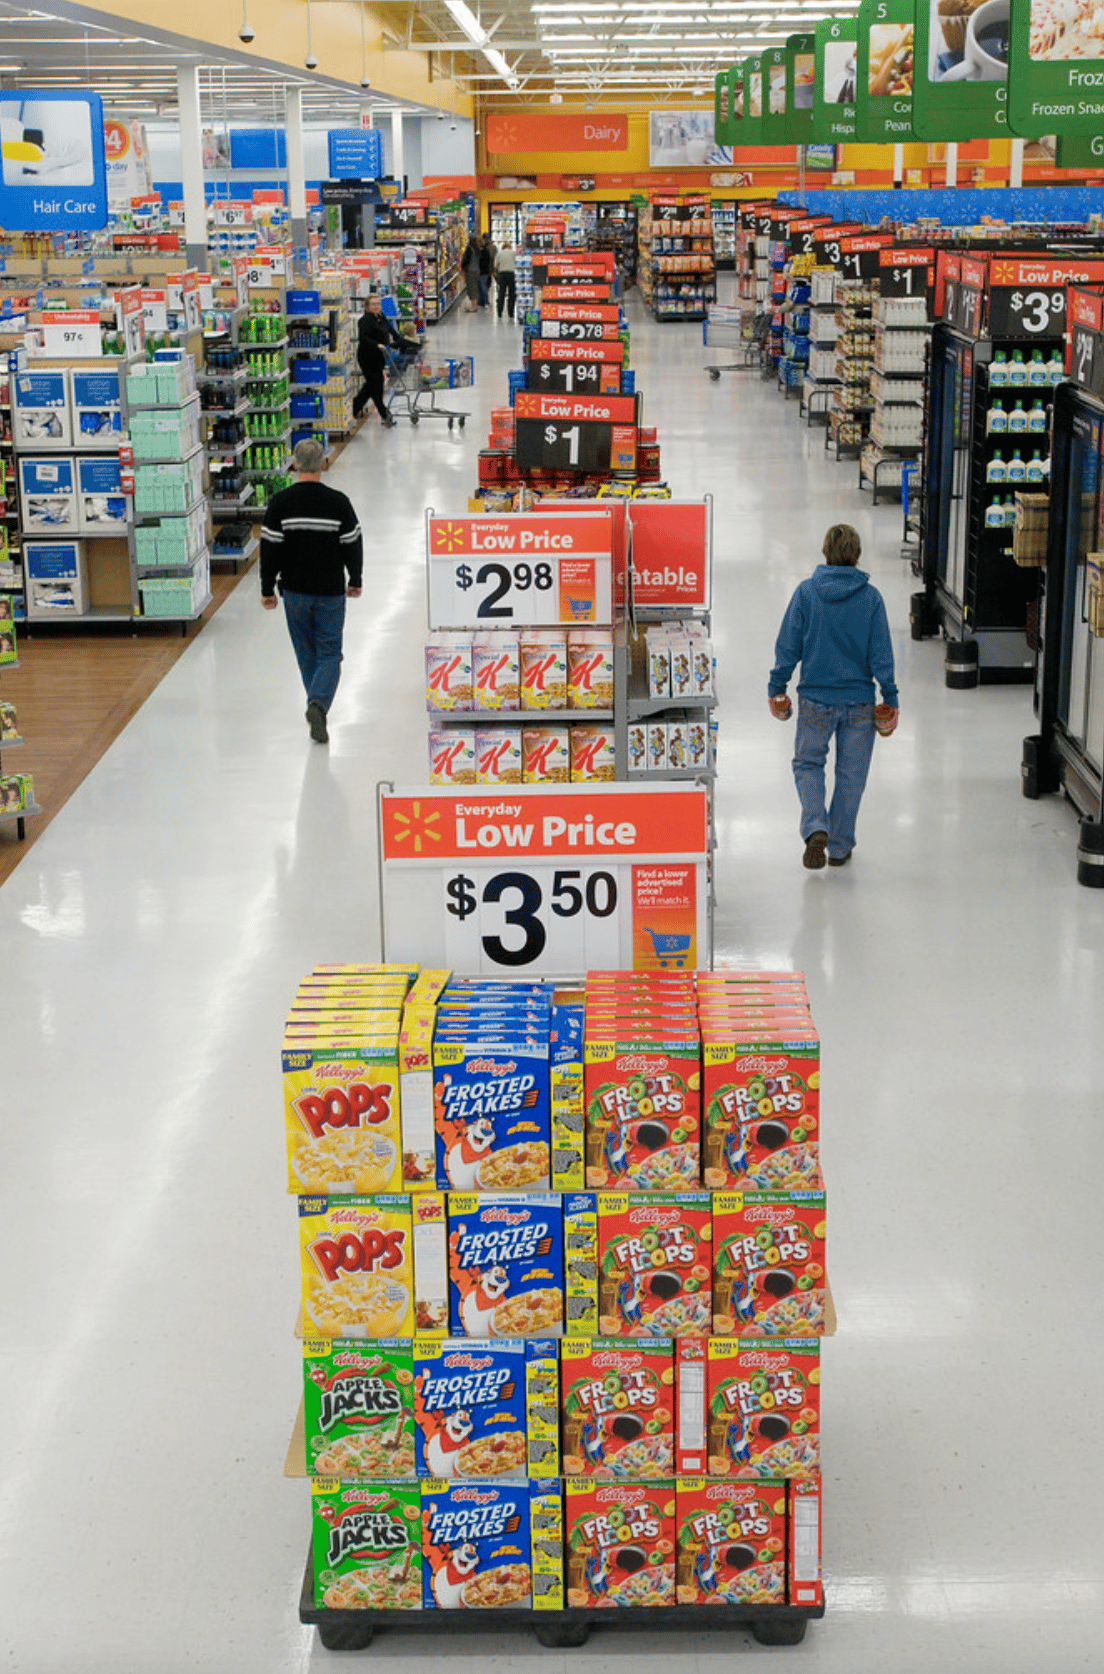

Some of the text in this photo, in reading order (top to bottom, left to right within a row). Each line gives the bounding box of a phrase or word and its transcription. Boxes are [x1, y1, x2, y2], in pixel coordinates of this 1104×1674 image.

[876, 4, 887, 18] 5
[800, 39, 807, 49] 7
[831, 24, 840, 37] 6
[773, 52, 781, 62] 8
[1032, 102, 1074, 115] Frozen
[584, 125, 621, 142] Dairy
[34, 200, 96, 213] Hair Care
[1018, 270, 1089, 283] Low Price
[551, 348, 605, 358] Low Price
[541, 403, 610, 418] Low Price
[470, 523, 510, 533] Everyday
[471, 531, 574, 550] Low Price
[456, 804, 522, 818] Everyday
[456, 814, 637, 848] Low Price
[637, 878, 683, 887] advertised
[444, 1075, 535, 1103] FROSTED
[298, 1082, 392, 1139] POPS
[446, 1092, 524, 1119] FLAKES
[618, 1092, 683, 1122] LOOPS
[738, 1092, 803, 1122] LOOPS
[459, 1224, 547, 1251] FROSTED
[313, 1229, 406, 1282] POPS
[461, 1239, 535, 1266] FLAKES
[631, 1243, 694, 1272] LOOPS
[745, 1242, 808, 1271] LOOPS
[333, 1378, 382, 1392] APPLE
[422, 1368, 511, 1396] FROSTED
[320, 1390, 399, 1427] JACKS
[425, 1383, 499, 1411] FLAKES
[594, 1387, 657, 1415] LOOPS
[741, 1387, 803, 1415] LOOPS
[342, 1515, 389, 1528] APPLE
[429, 1503, 515, 1529] FROSTED
[328, 1526, 406, 1563] JACKS
[432, 1519, 504, 1544] FLAKES
[597, 1521, 659, 1548] LOOPS
[707, 1519, 768, 1547] LOOPS
